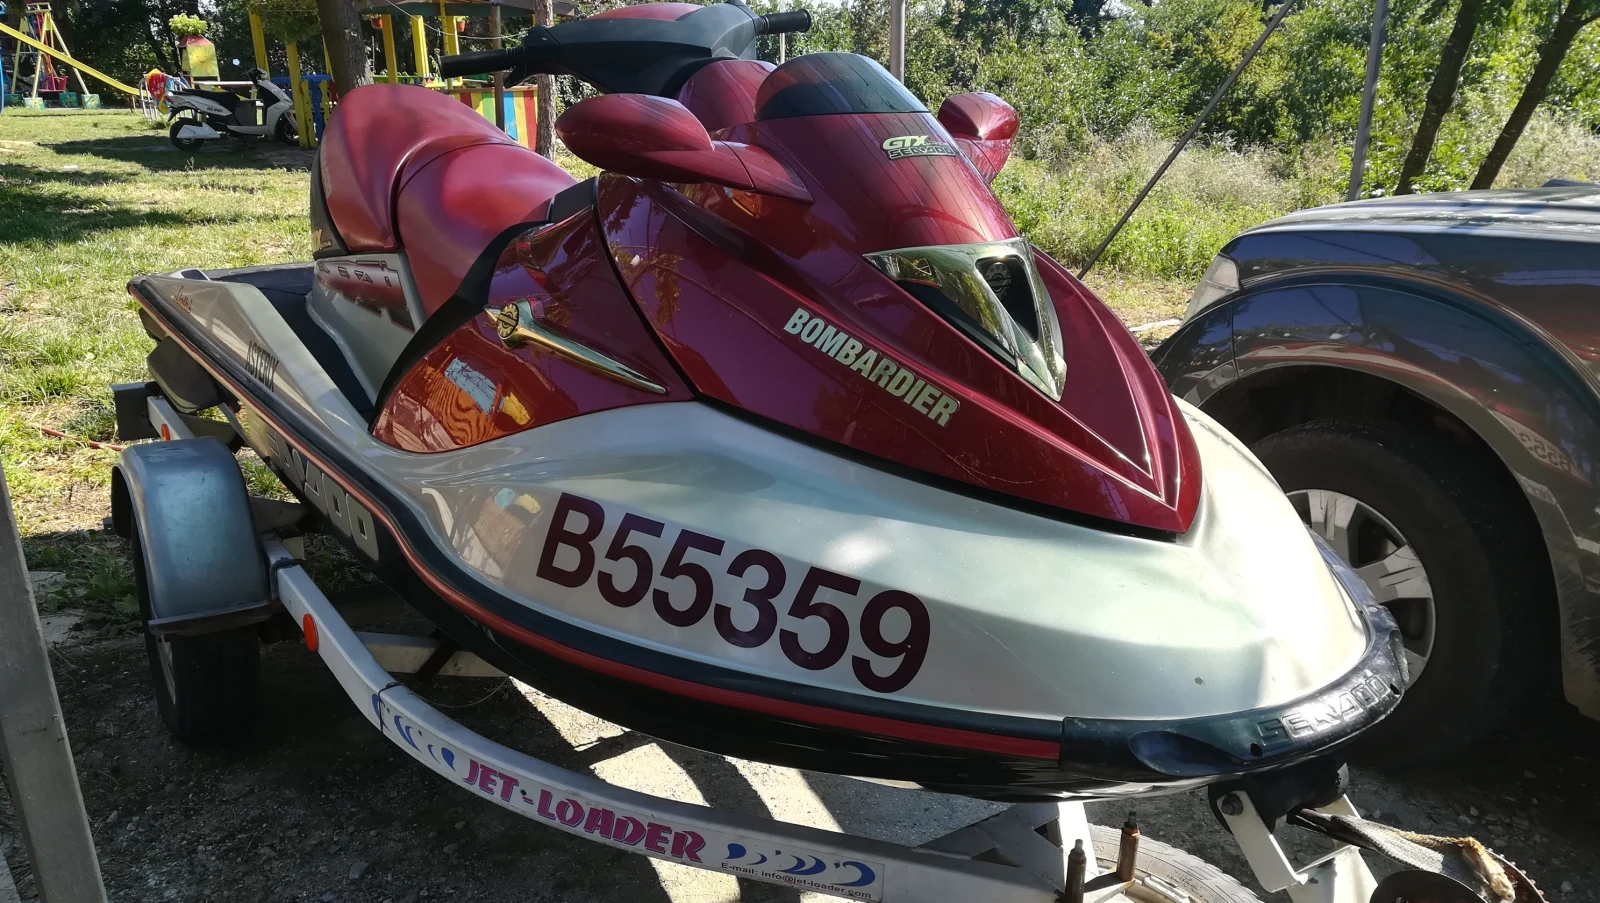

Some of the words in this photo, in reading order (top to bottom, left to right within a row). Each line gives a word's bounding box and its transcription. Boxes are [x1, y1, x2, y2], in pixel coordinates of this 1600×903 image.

[882, 135, 928, 150] GTX
[783, 307, 960, 428] BOMBARDIER
[536, 492, 931, 694] B55359
[463, 759, 706, 863] JET-LOADER
[721, 862, 758, 876] E-mail:
[761, 870, 872, 899] info@jet-loader.com
